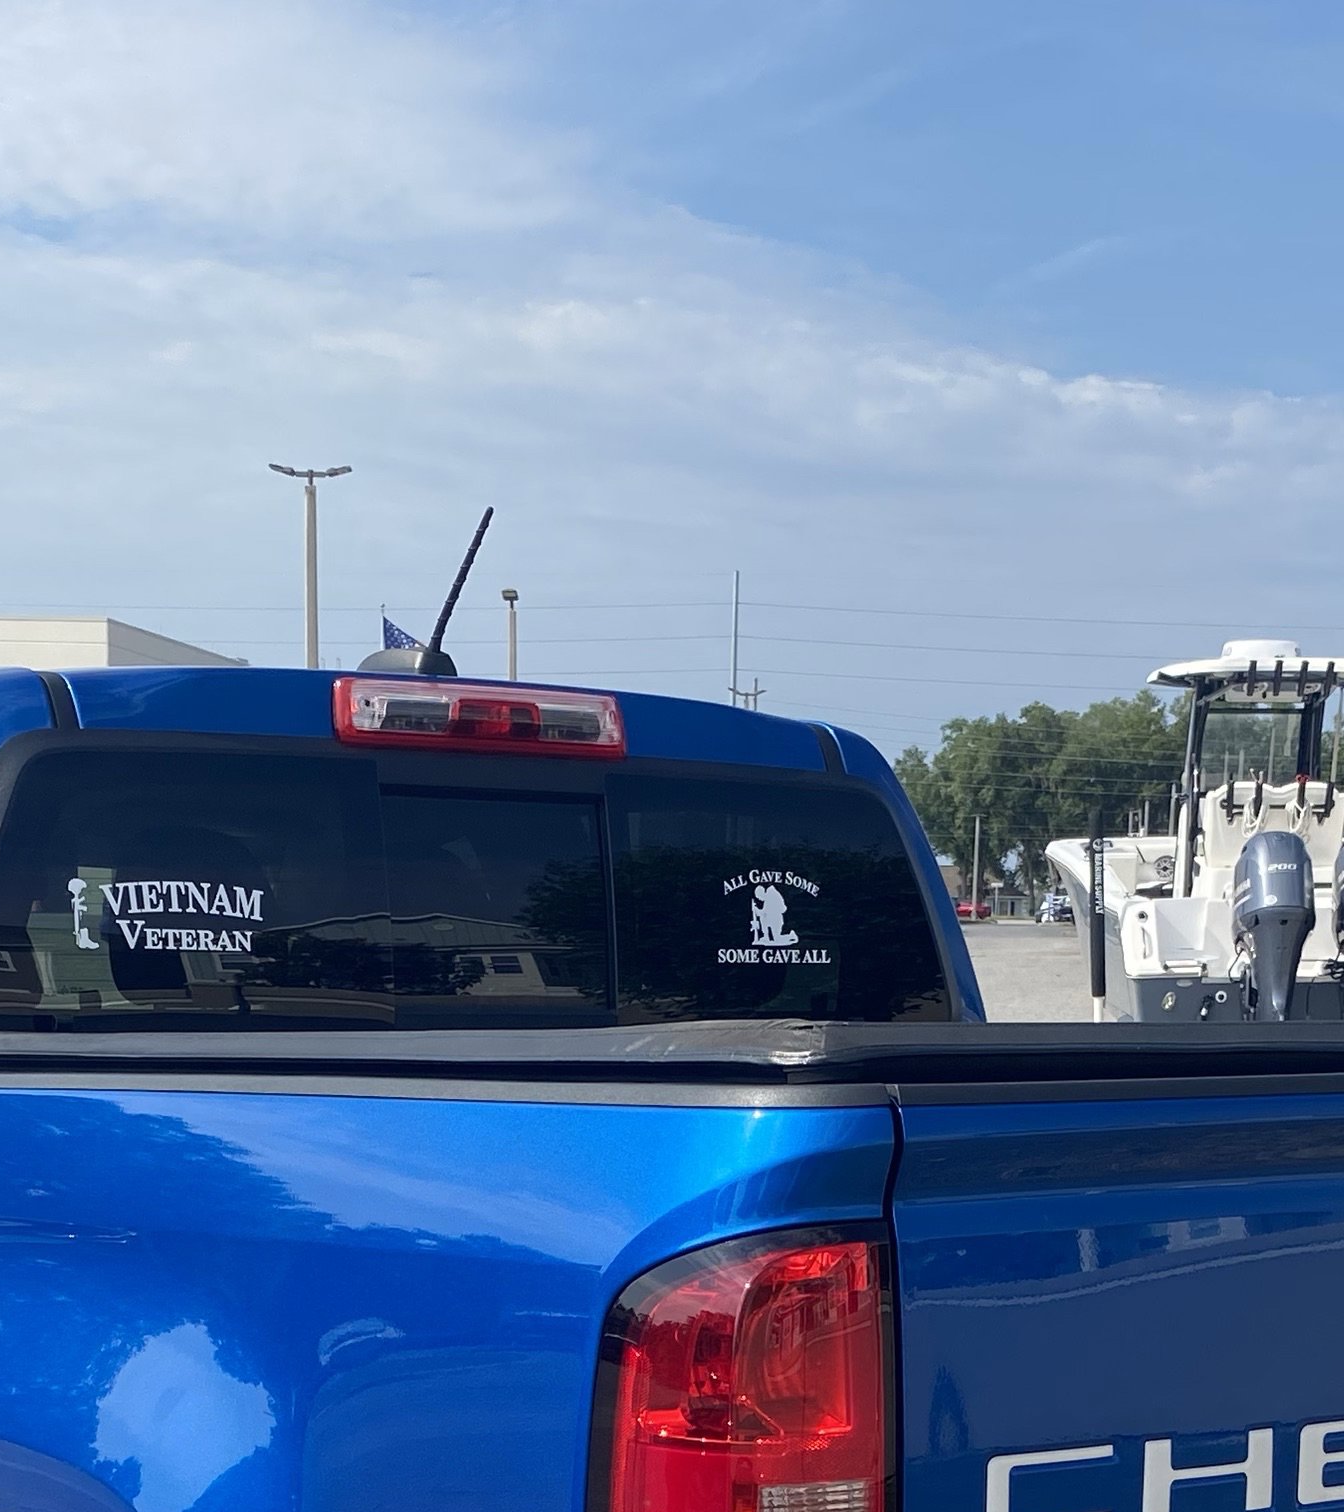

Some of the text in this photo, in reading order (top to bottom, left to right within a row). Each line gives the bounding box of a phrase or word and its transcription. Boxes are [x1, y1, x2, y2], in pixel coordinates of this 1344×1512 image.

[1267, 863, 1297, 871] 200
[723, 869, 820, 897] ALL GAVE SOME
[99, 880, 264, 922] VIETNAM
[115, 919, 253, 952] VETERAN
[718, 949, 832, 964] SOME GAVE ALL
